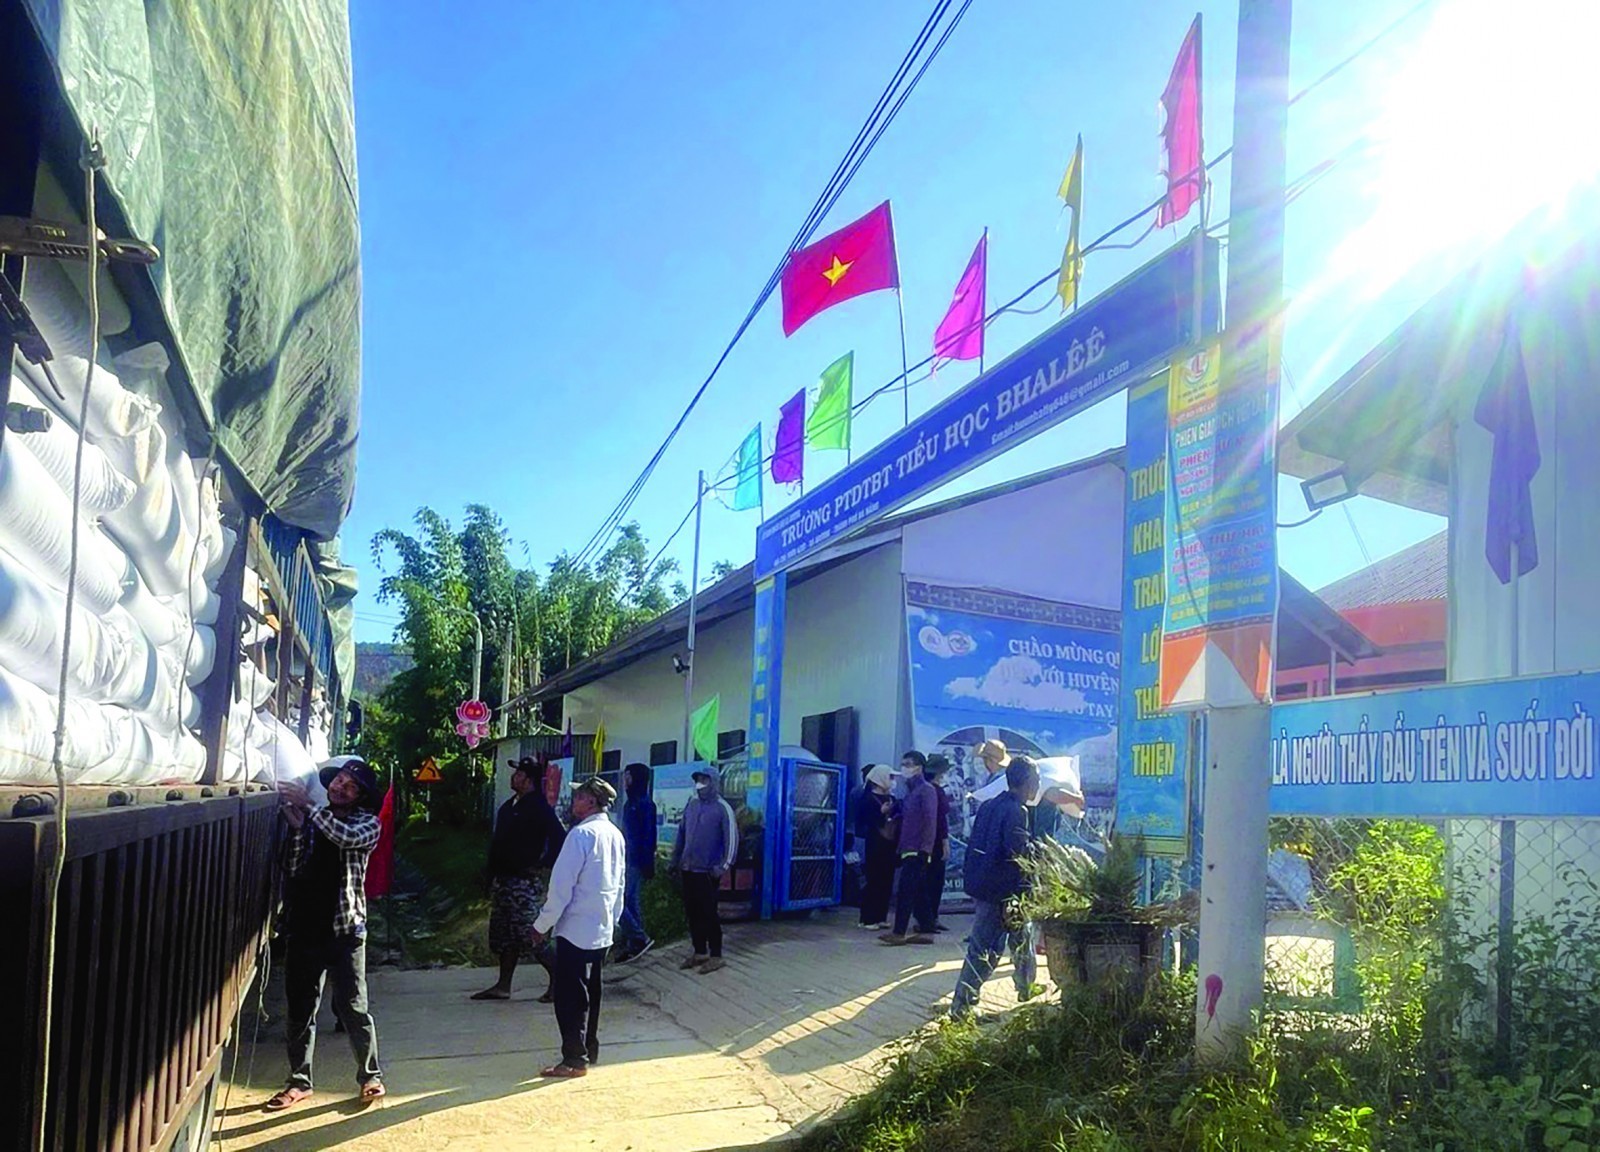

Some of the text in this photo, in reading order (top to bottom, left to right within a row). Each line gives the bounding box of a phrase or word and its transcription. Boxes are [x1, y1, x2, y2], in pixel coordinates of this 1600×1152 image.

[782, 503, 831, 547] TRƯỜNG
[834, 463, 893, 517] PTDTBT
[896, 431, 939, 478] TIỂU
[944, 403, 989, 452] HỌC
[996, 326, 1105, 421] BHALÊÊ
[1009, 635, 1053, 658] CHÀO
[1055, 640, 1103, 664] MỪNG
[1067, 671, 1120, 696] HUYỆN
[1087, 702, 1114, 718] TAY
[1132, 736, 1176, 784] THIỆN
[1272, 699, 1593, 785] LÀ NGƯỜI THẦY ĐẦU TIÊN VÀ SUỐT ĐỜI
